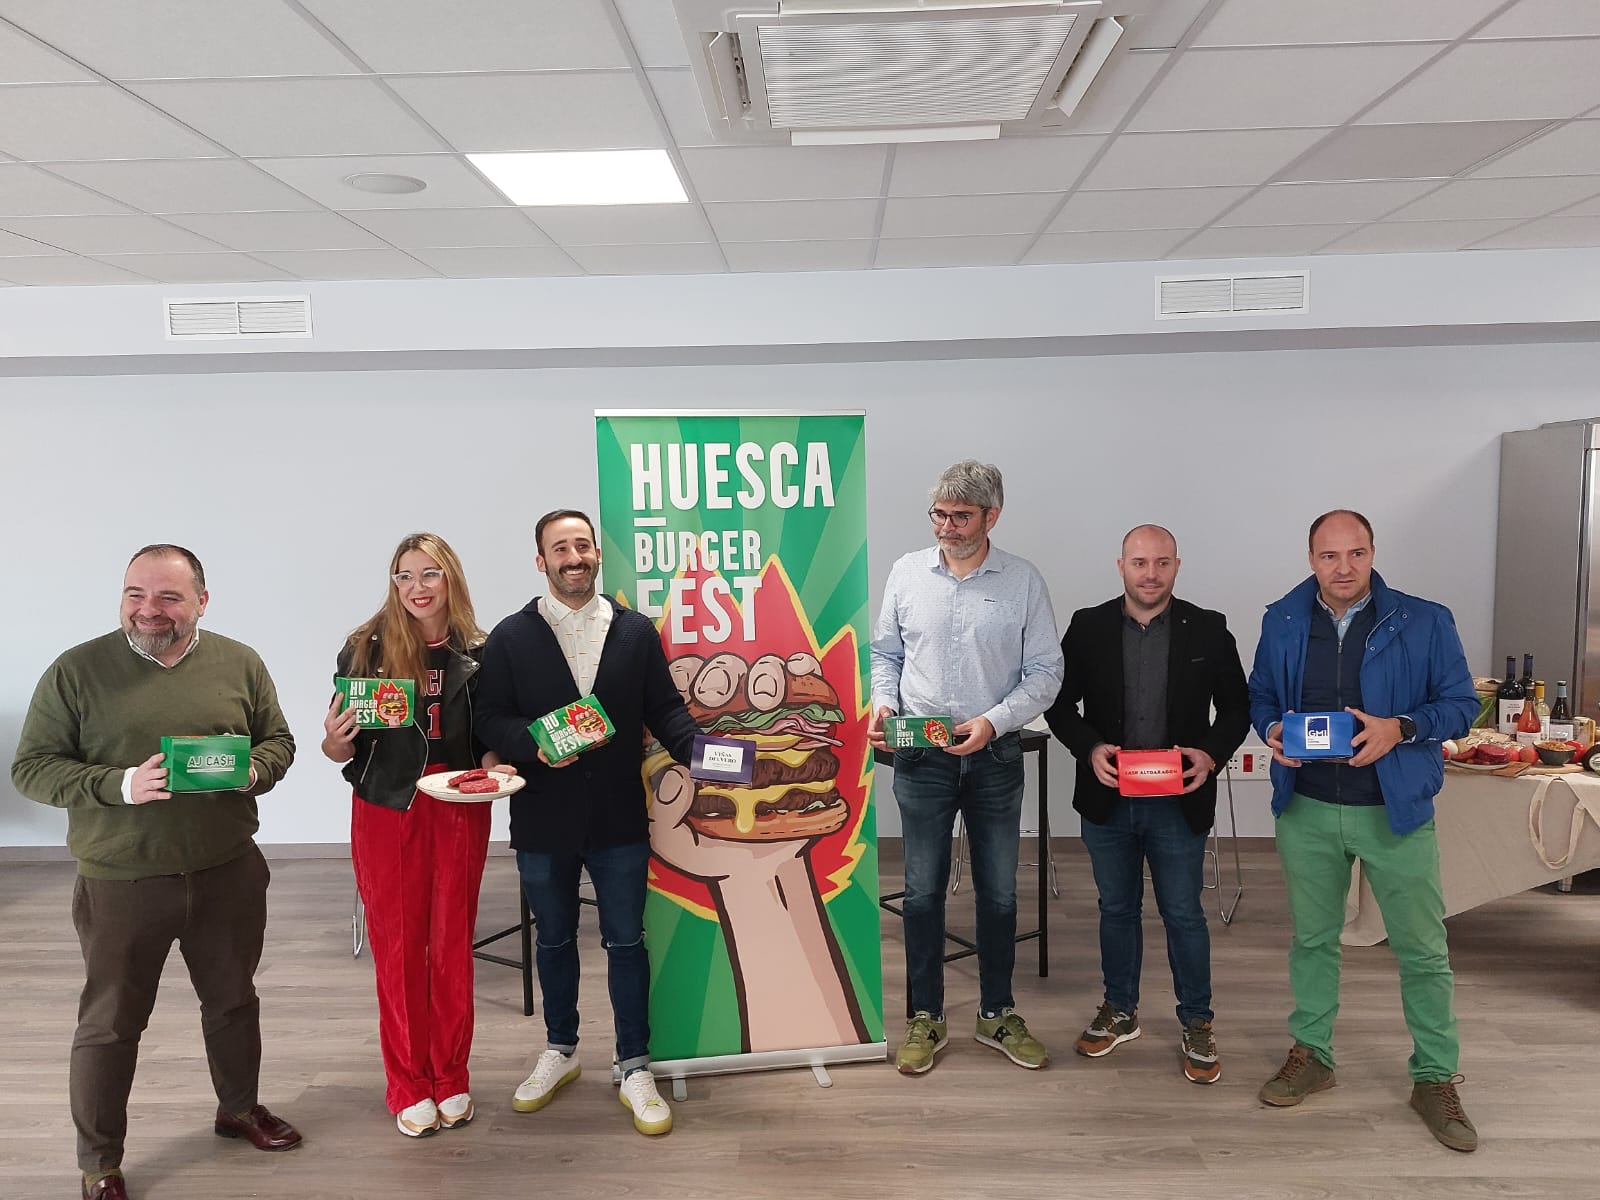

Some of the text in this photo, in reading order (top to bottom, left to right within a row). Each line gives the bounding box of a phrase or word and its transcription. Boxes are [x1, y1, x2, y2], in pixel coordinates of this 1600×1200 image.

[630, 441, 835, 510] HUESCA
[633, 530, 762, 573] BURGER
[636, 575, 763, 645] FEST
[350, 681, 366, 696] HU
[356, 708, 378, 724] EST
[541, 713, 560, 732] HU
[896, 719, 907, 730] HU
[550, 725, 577, 743] BURGER
[896, 737, 914, 747] FEST
[553, 733, 582, 757] FEST
[187, 756, 202, 768] AJ
